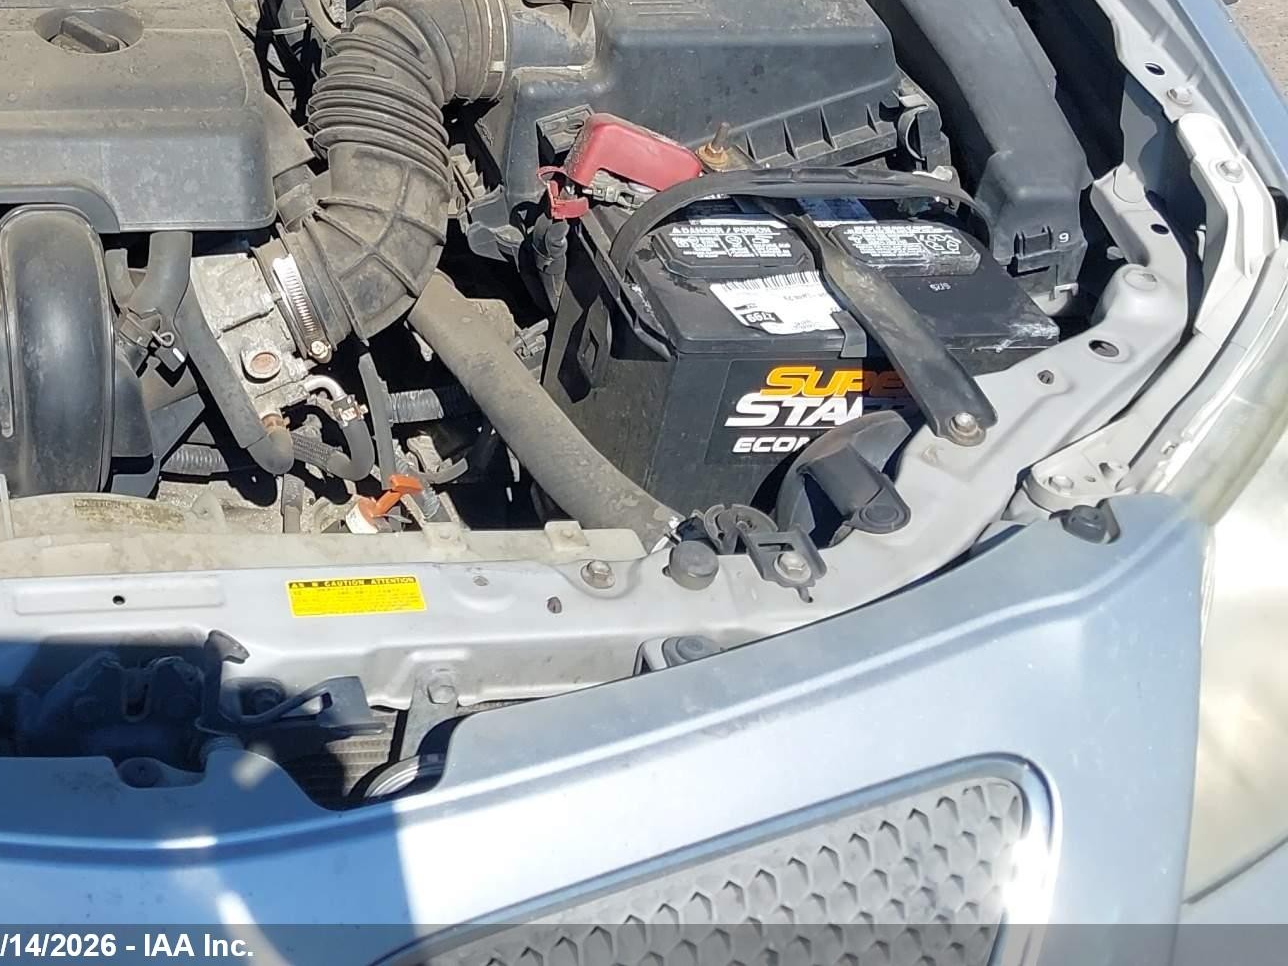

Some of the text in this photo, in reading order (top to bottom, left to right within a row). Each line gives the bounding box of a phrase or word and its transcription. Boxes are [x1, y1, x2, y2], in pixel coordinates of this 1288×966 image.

[680, 226, 724, 234] DANGER
[732, 226, 772, 234] POISON
[760, 365, 906, 398] SUPE
[724, 392, 872, 428] STA
[324, 579, 365, 587] CAUTION
[371, 577, 415, 585] ATTENTION
